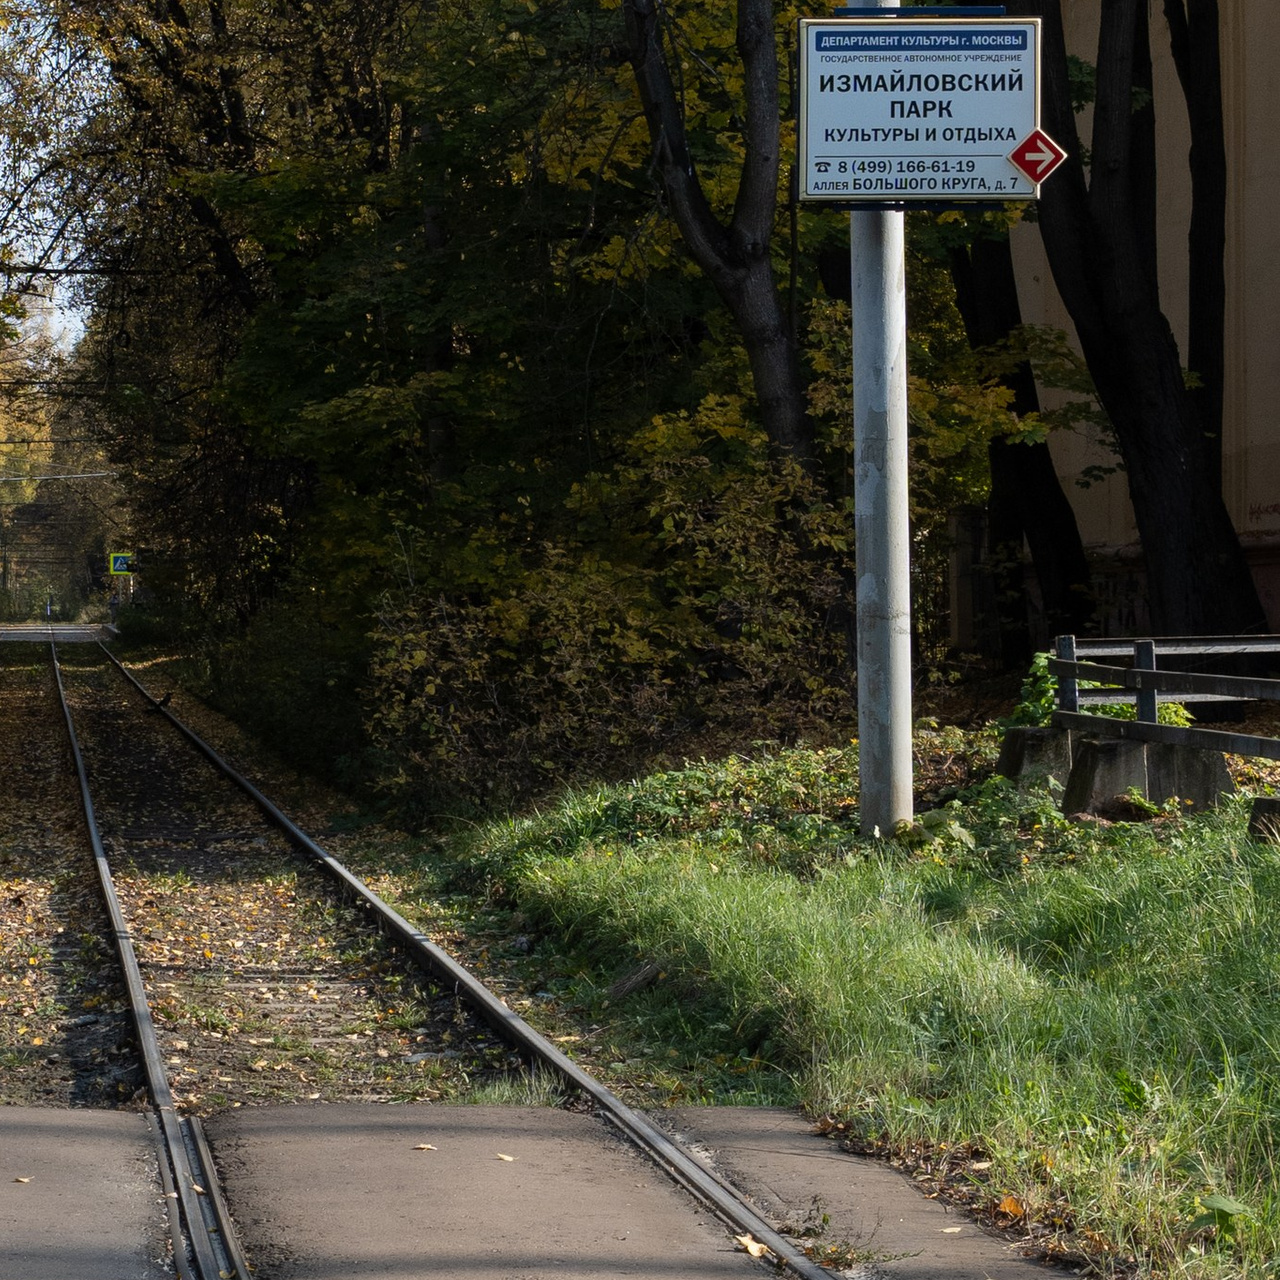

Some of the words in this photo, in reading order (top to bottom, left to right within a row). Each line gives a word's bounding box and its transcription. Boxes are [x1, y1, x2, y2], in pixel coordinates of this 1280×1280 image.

[821, 36, 899, 47] ДЕПАРТАМЕНТ
[901, 36, 959, 46] КУЛЬТУРЫ
[972, 36, 1022, 45] МОСКВЫ
[820, 55, 902, 63] ГОСУДАРСТВЕННОЕ
[904, 54, 962, 62] АВТОНОМНОЕ
[964, 54, 1022, 62] УЧРЕЖДЕНИЕ
[820, 69, 1023, 92] ИЗМАЙЛОВСКИЙ
[890, 100, 953, 118] ПАРК
[825, 128, 919, 141] КУЛЬТУРЫ
[926, 128, 936, 141] И
[942, 127, 1017, 143] ОТДЫХА
[838, 161, 847, 173] 8
[852, 160, 892, 174] (499)
[896, 160, 975, 173] 166-61-19
[813, 181, 849, 190] АЛЛЕЯ
[853, 178, 937, 190] БОЛЬШОГО
[942, 177, 991, 191] КРУГА,
[995, 180, 1006, 191] д.
[1010, 177, 1018, 189] 7
